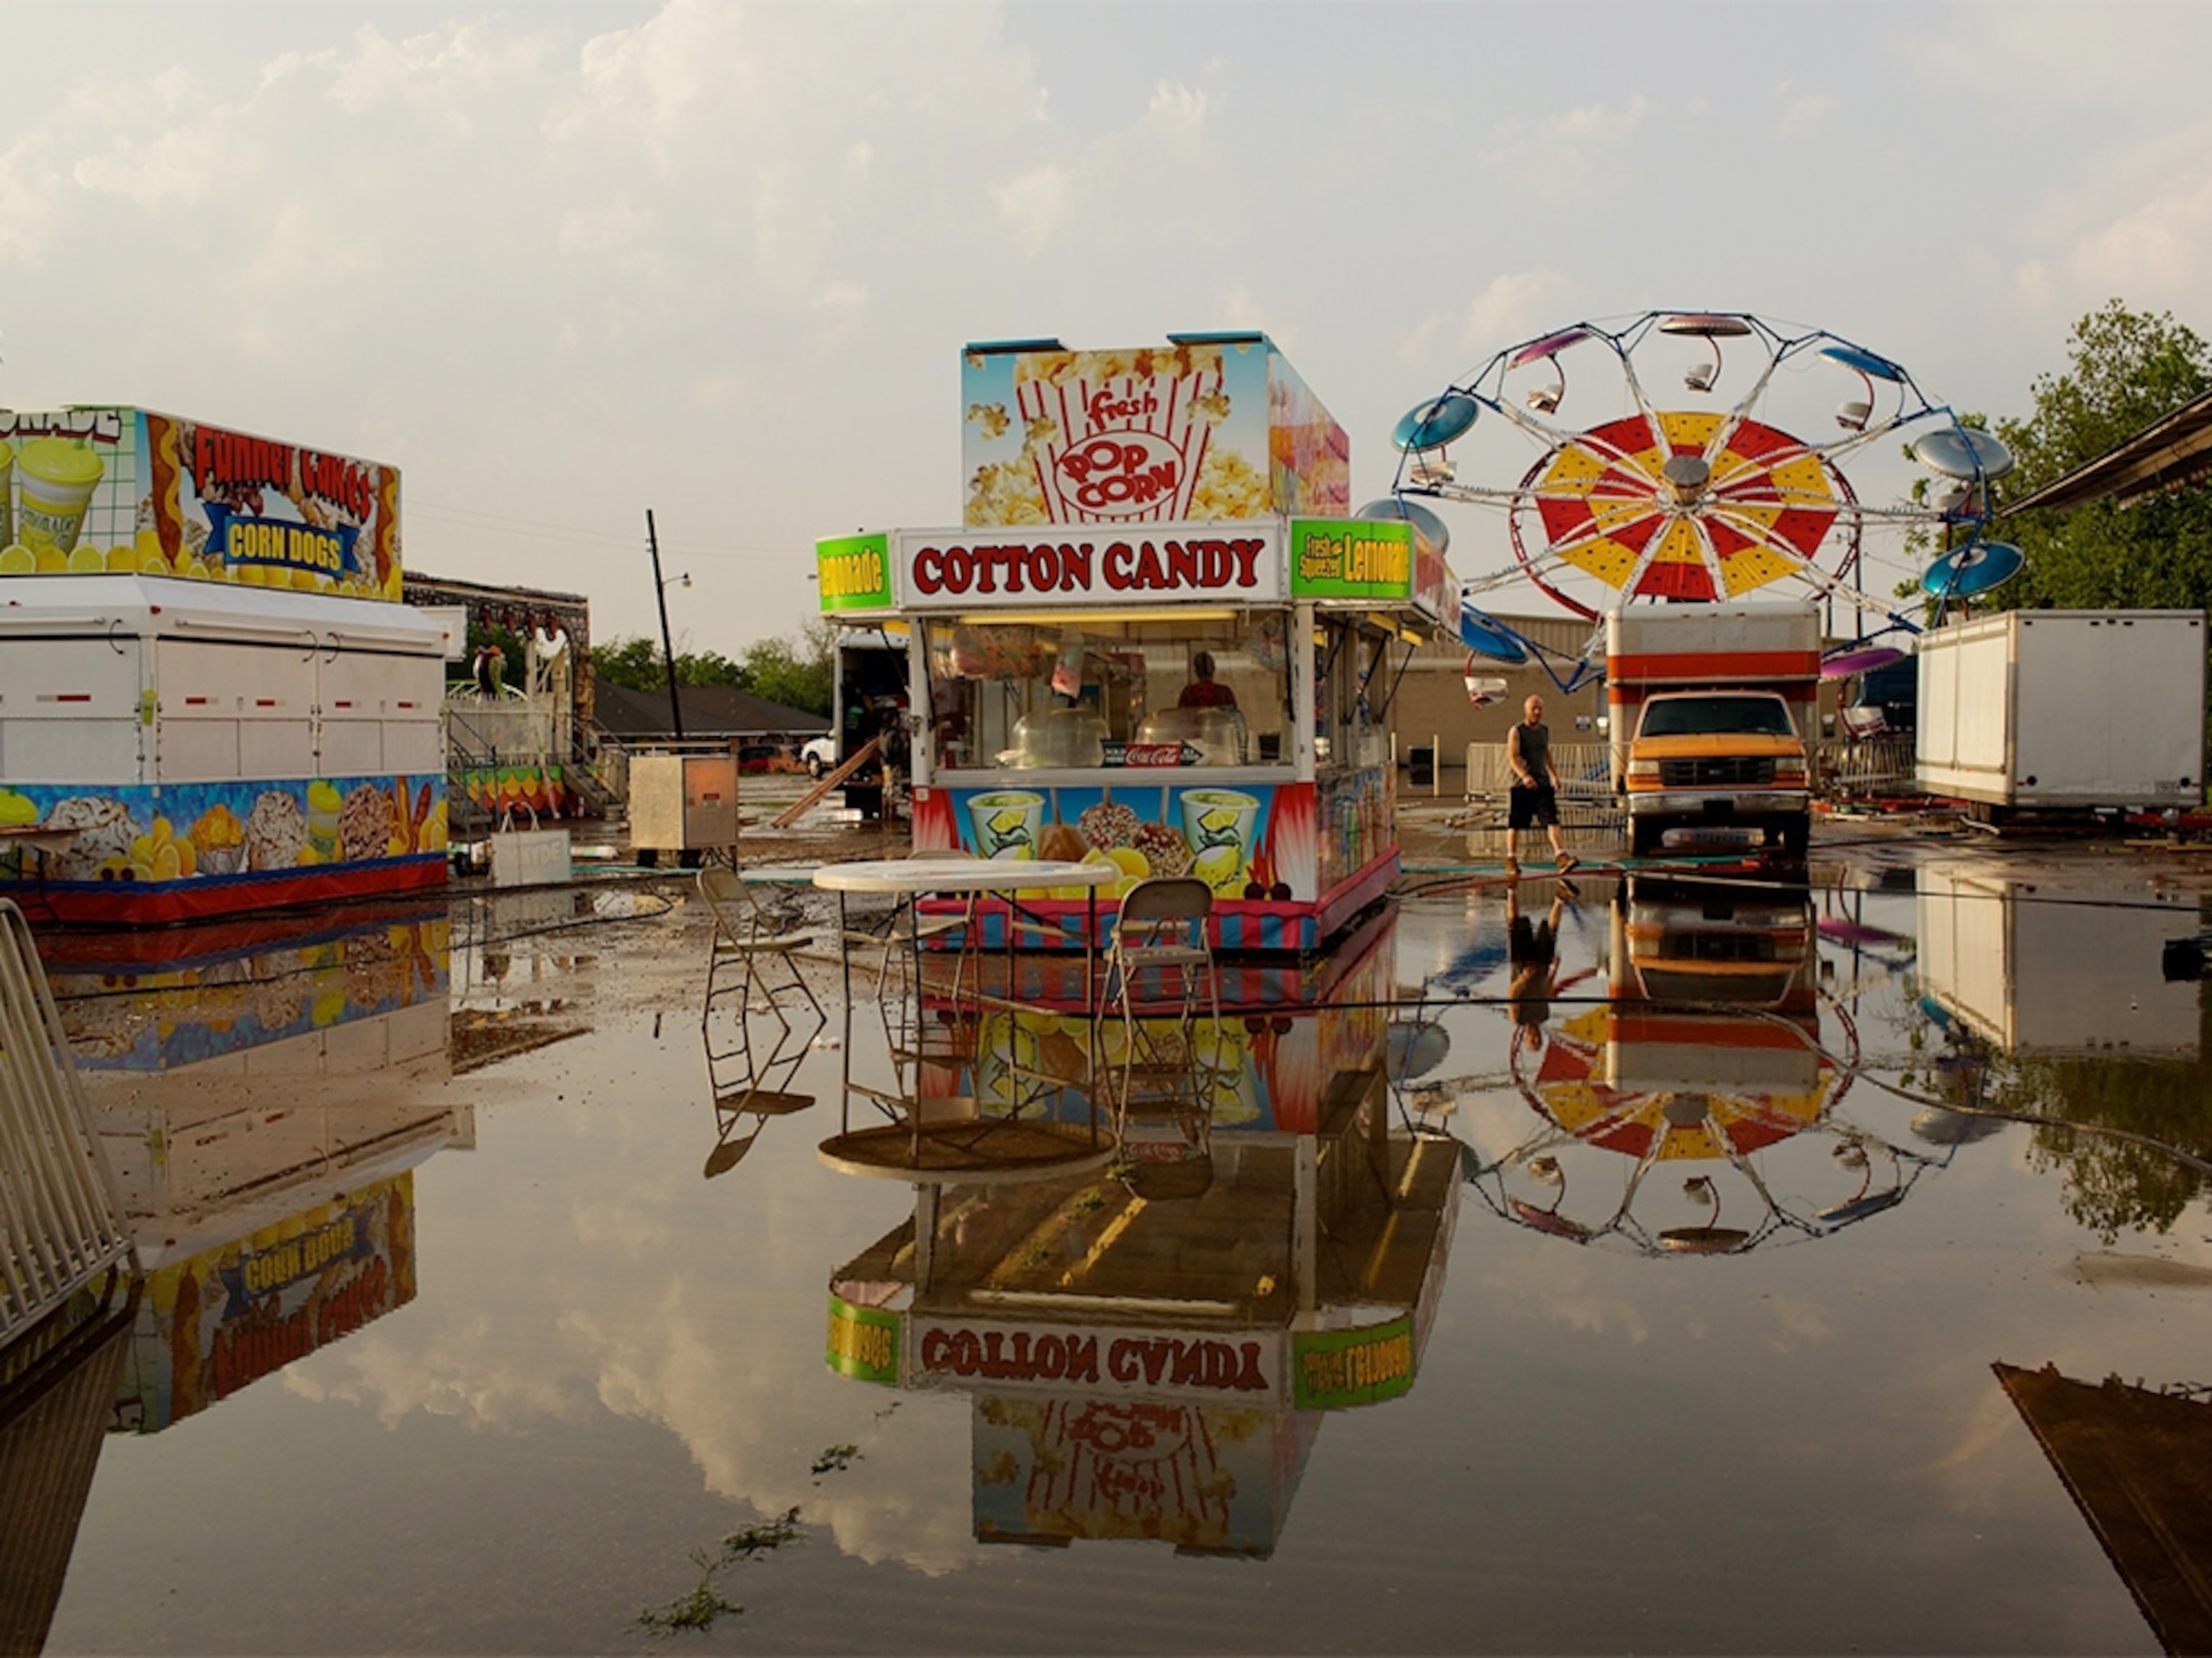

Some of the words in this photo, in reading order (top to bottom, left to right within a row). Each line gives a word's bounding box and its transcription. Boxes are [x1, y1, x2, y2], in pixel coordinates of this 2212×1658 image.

[1089, 390, 1158, 431] fresh
[1061, 440, 1148, 484] POP
[1077, 460, 1176, 507] CORN
[228, 523, 285, 560] CORN
[289, 528, 341, 572] DOGS
[913, 543, 1094, 595] COTTON
[1102, 539, 1265, 591] CANDY
